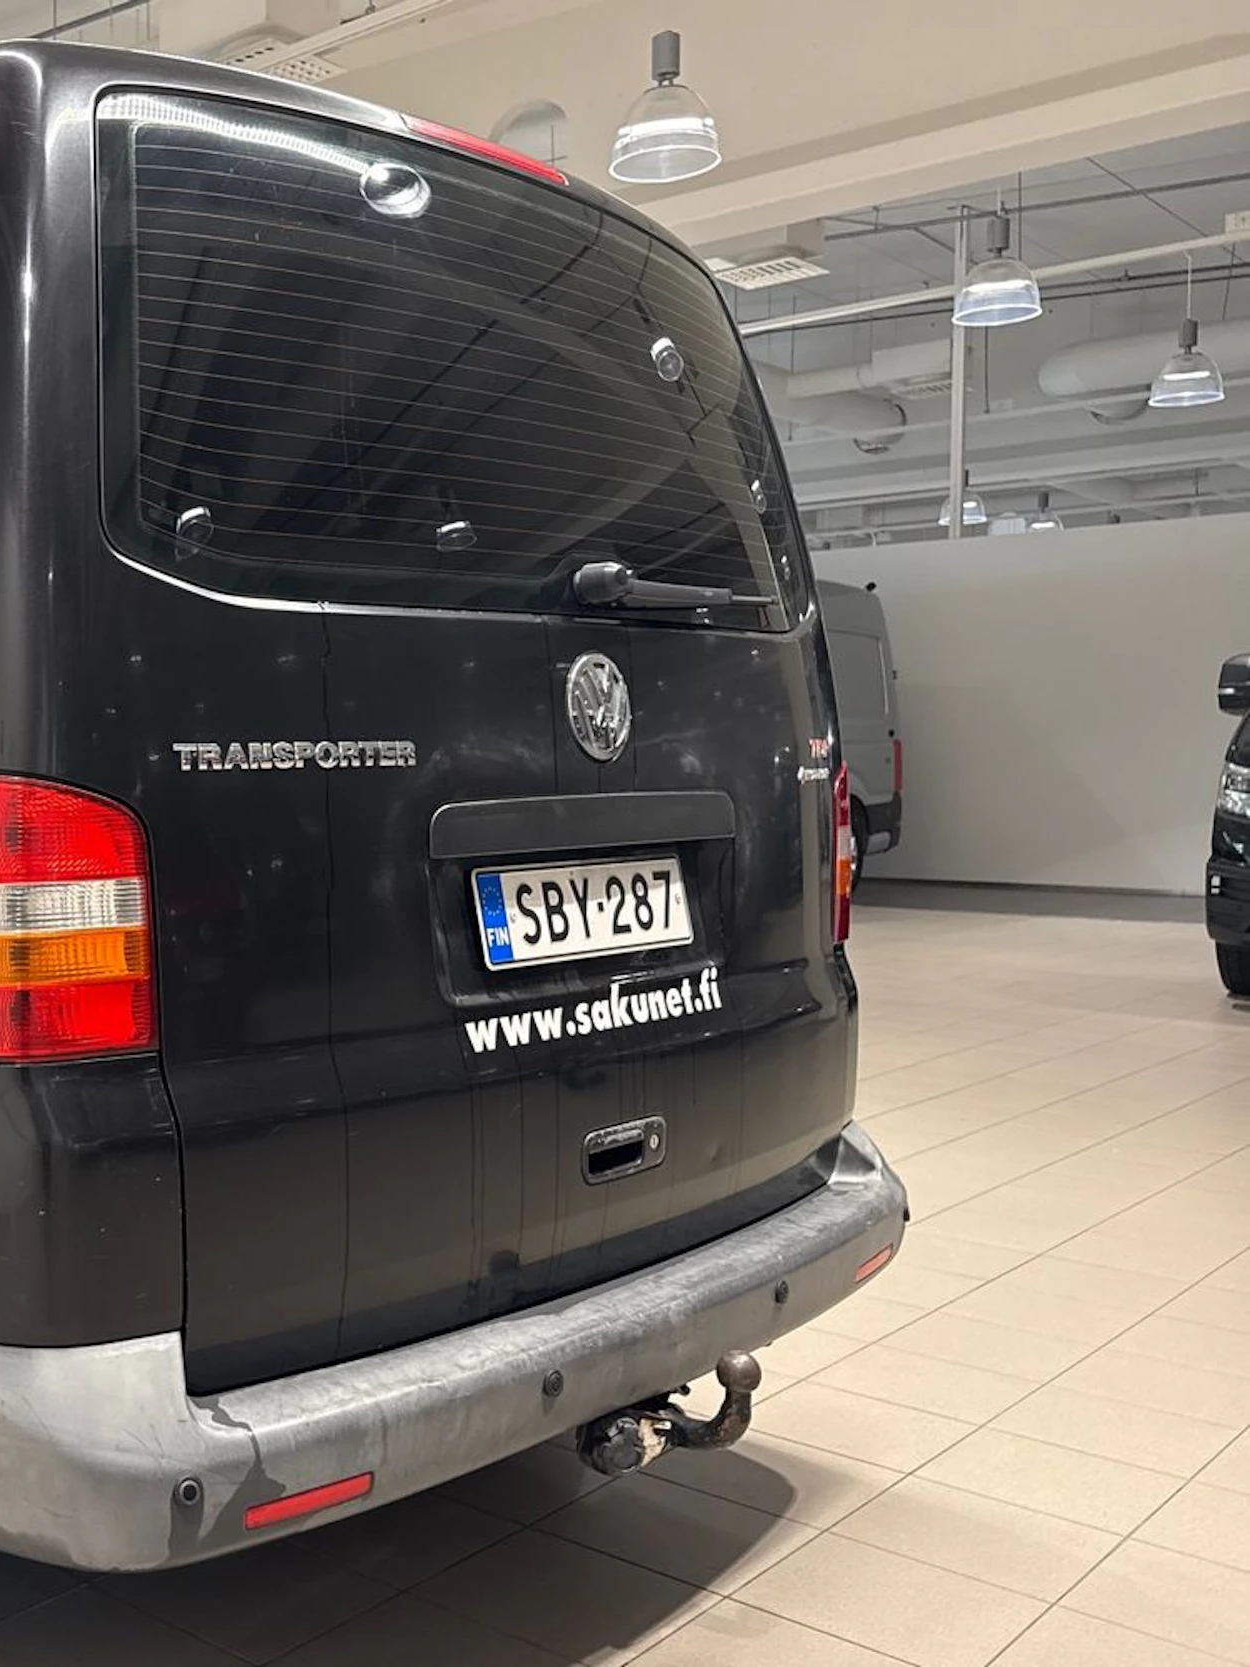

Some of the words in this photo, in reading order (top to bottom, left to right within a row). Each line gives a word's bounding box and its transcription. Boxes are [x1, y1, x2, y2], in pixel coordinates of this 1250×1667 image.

[172, 740, 417, 771] TRANSPORTER
[486, 927, 511, 948] FIN
[515, 869, 671, 945] SBY-287
[464, 966, 723, 1053] www.sakunet.fi
